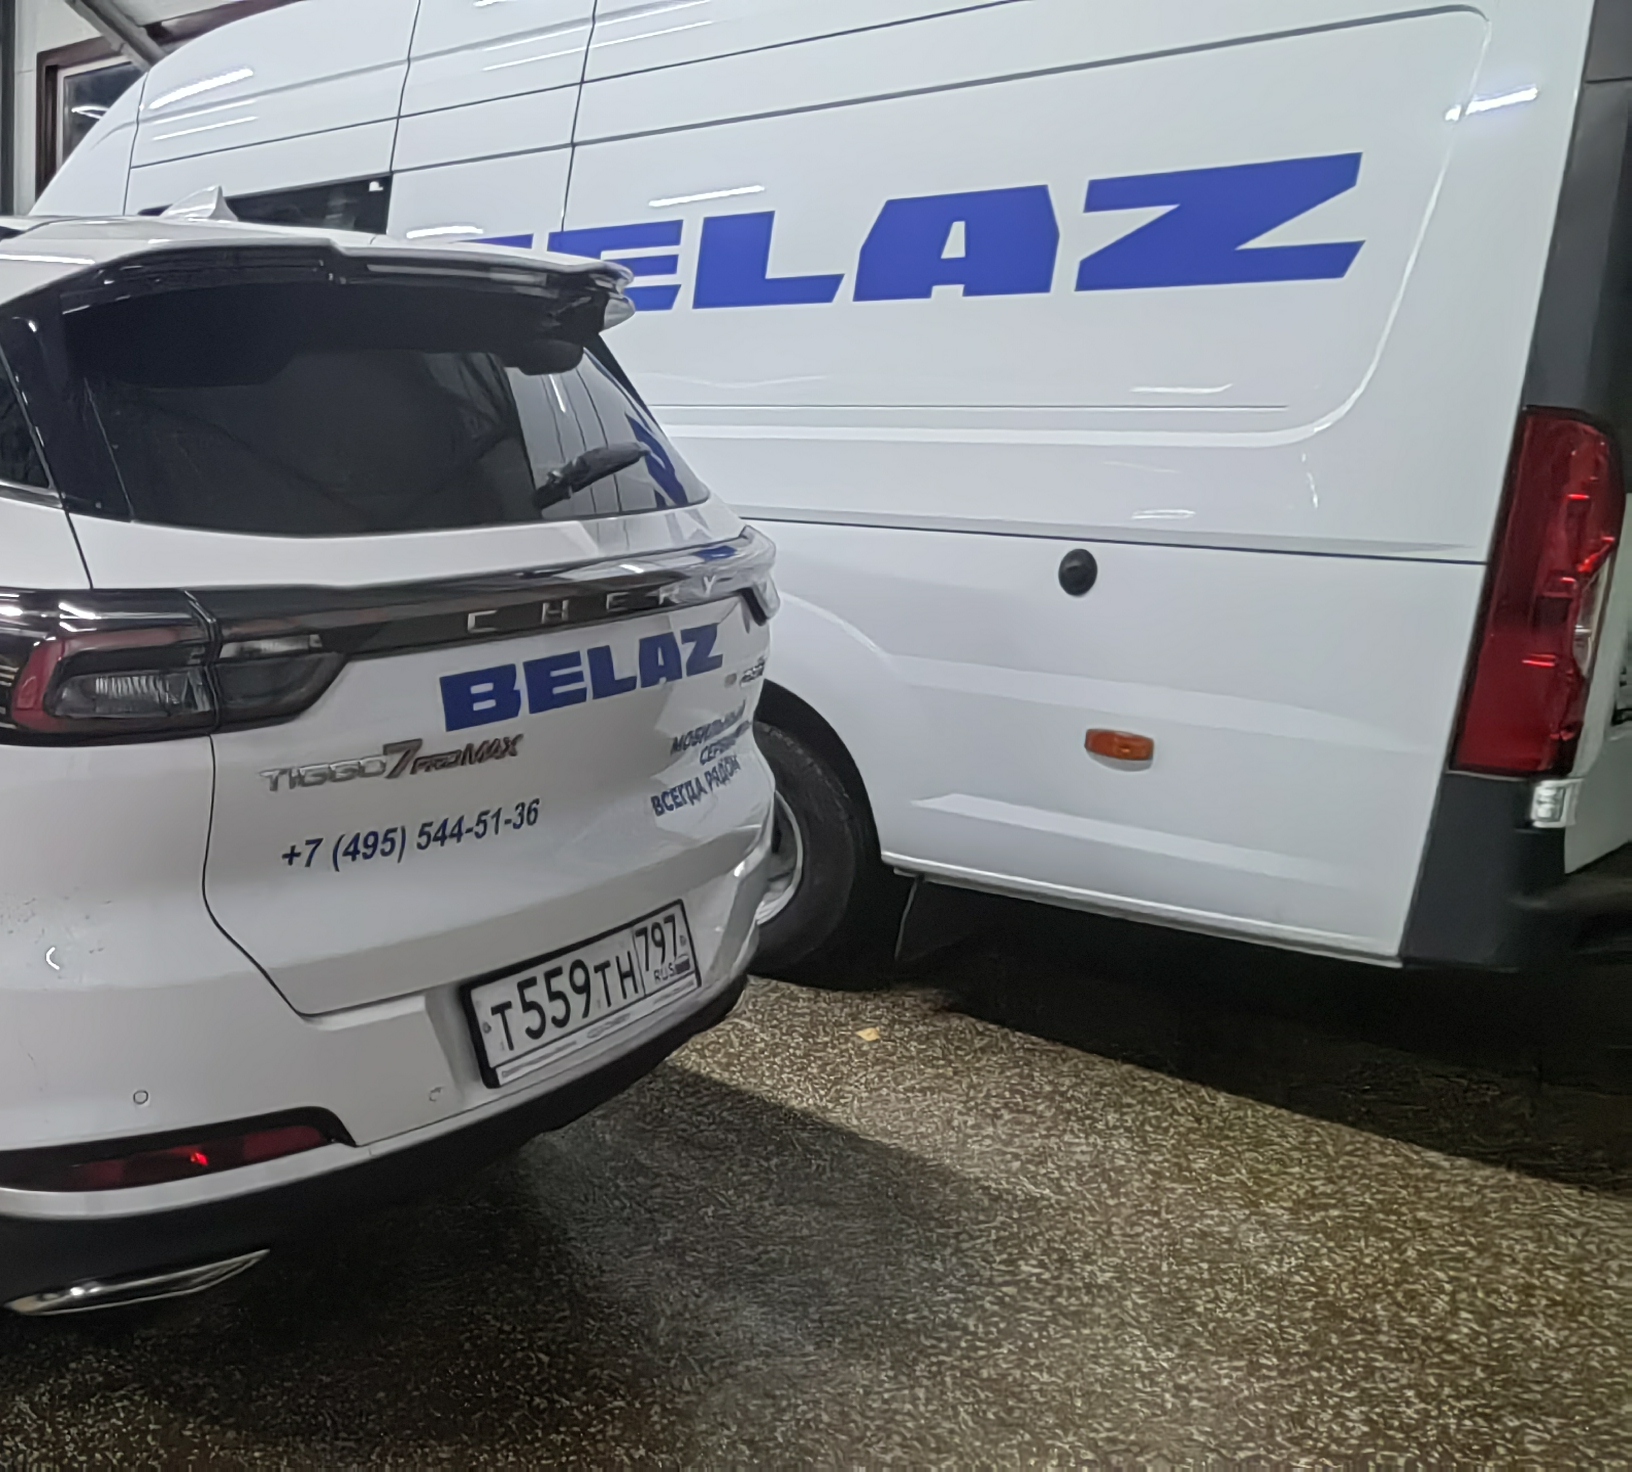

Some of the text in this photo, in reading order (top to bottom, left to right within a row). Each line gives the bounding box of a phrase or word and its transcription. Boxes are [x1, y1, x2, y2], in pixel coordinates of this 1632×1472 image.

[451, 151, 1366, 311] ELAZ
[467, 574, 717, 633] CHERY
[439, 622, 724, 732] BELAZ
[650, 776, 709, 817] ВСЕГДА
[281, 798, 541, 872] +7 (495) 544-51-36
[634, 913, 678, 972] 797
